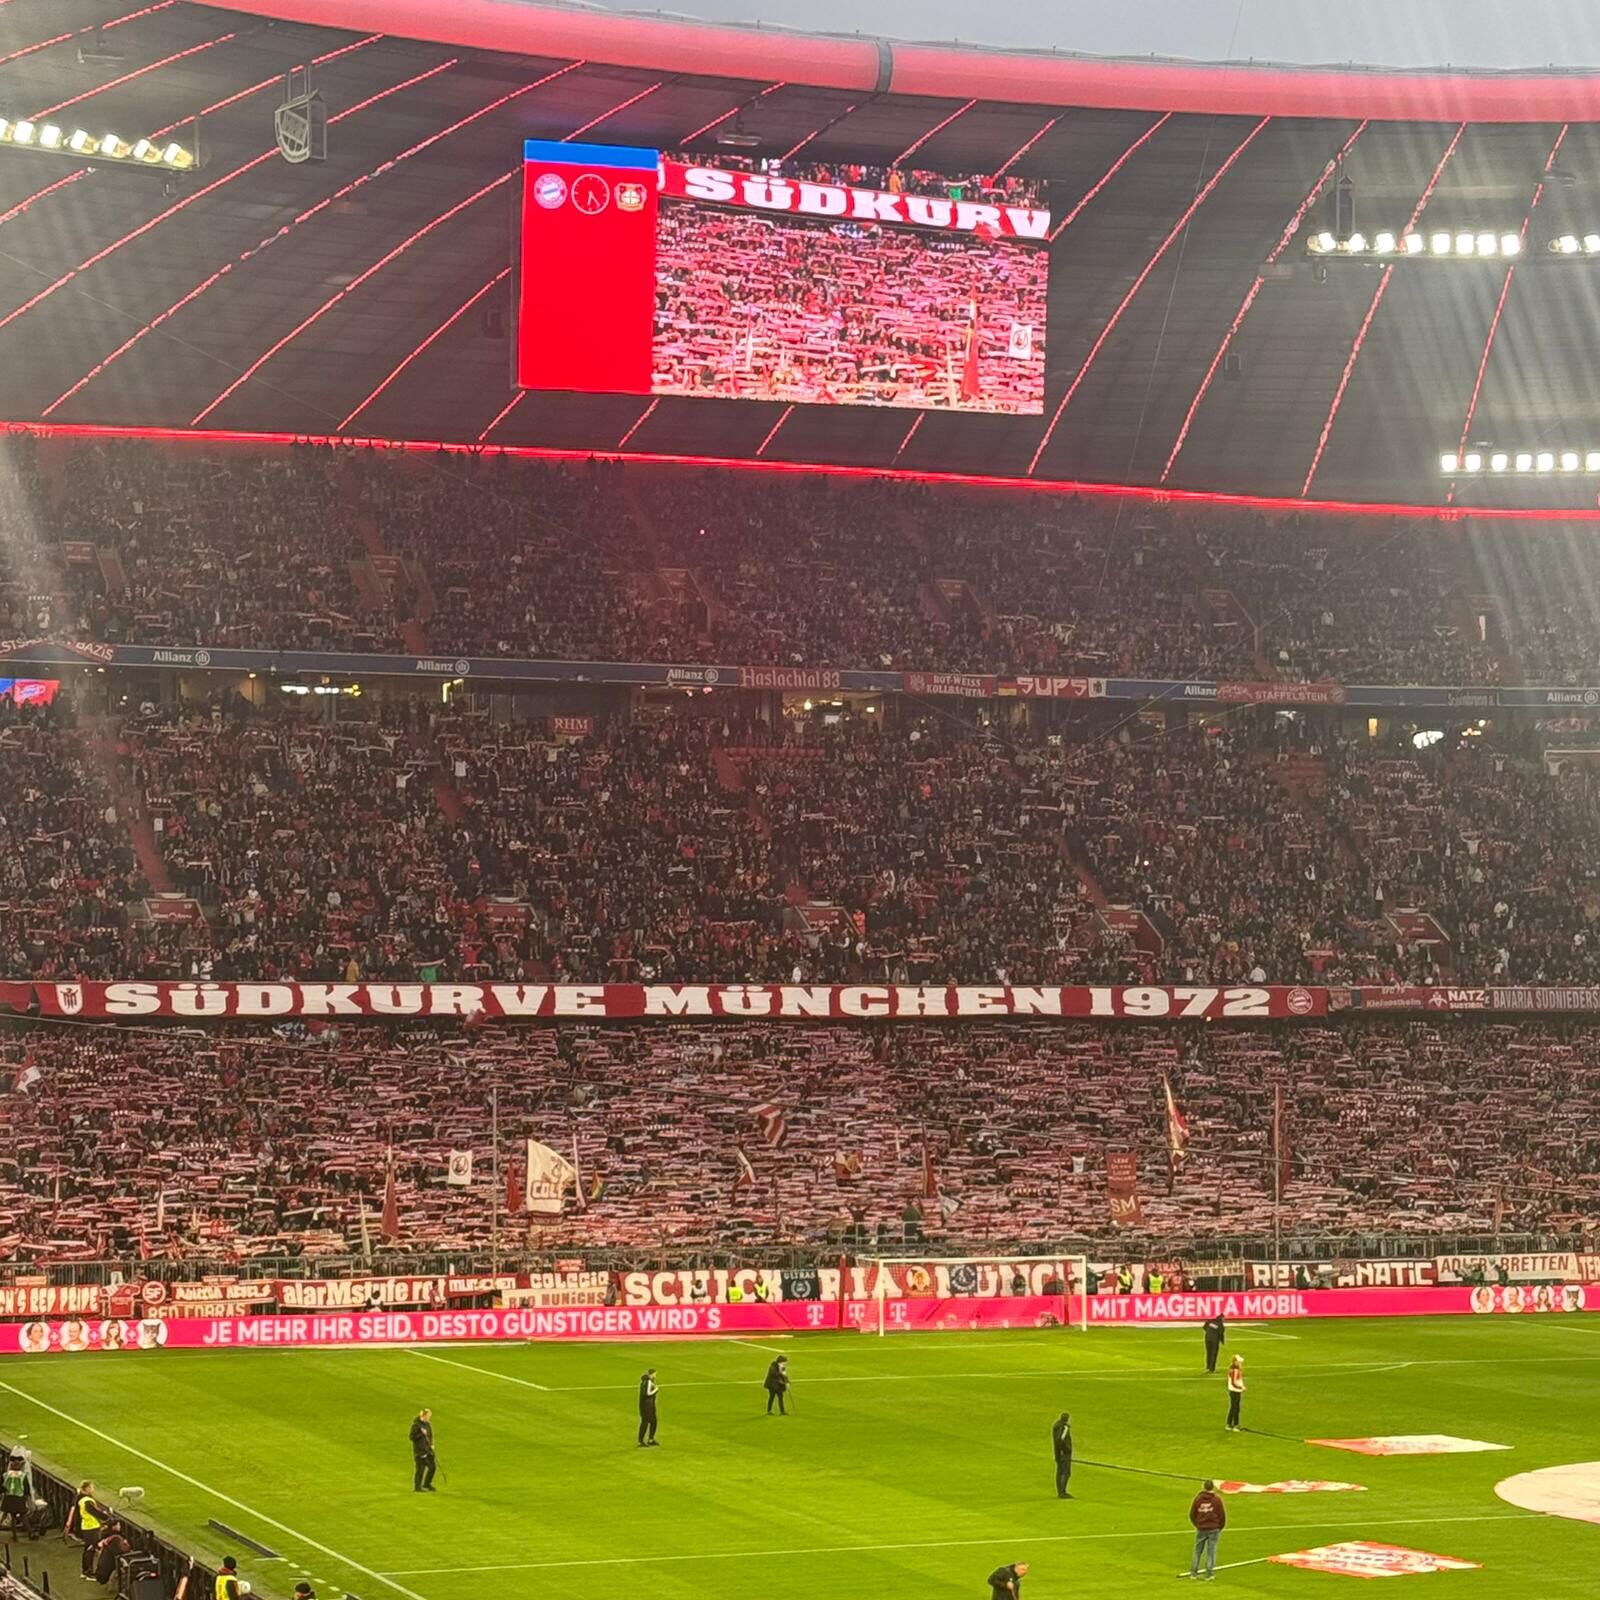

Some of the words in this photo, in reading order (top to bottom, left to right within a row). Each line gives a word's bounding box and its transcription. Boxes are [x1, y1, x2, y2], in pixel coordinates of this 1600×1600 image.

[153, 650, 192, 663] Allianz
[416, 660, 453, 672] Allianz
[667, 668, 703, 681] Allianz
[741, 667, 820, 688] Haslachtal
[823, 671, 840, 688] 83
[1546, 691, 1582, 703] Allianz
[1089, 988, 1270, 1016] 1972
[1447, 990, 1485, 1002] NATZ
[1493, 990, 1534, 1009] BAVARIA
[1111, 1195, 1136, 1214] SM
[1500, 1255, 1569, 1272] BRETTEN
[624, 1266, 902, 1306] SCHICKRIA
[60, 1286, 99, 1312] PRIDE
[509, 1296, 535, 1309] RD
[1092, 1295, 1130, 1319] MIT
[1135, 1293, 1238, 1318] MAGENTA
[1242, 1293, 1308, 1316] MOBIL
[203, 1322, 231, 1344] JE
[238, 1319, 306, 1343] MEHR
[313, 1317, 353, 1339] IHR
[358, 1314, 417, 1340] SEID,
[423, 1312, 497, 1337] DESTO
[503, 1308, 632, 1335] GÜNSTIGER
